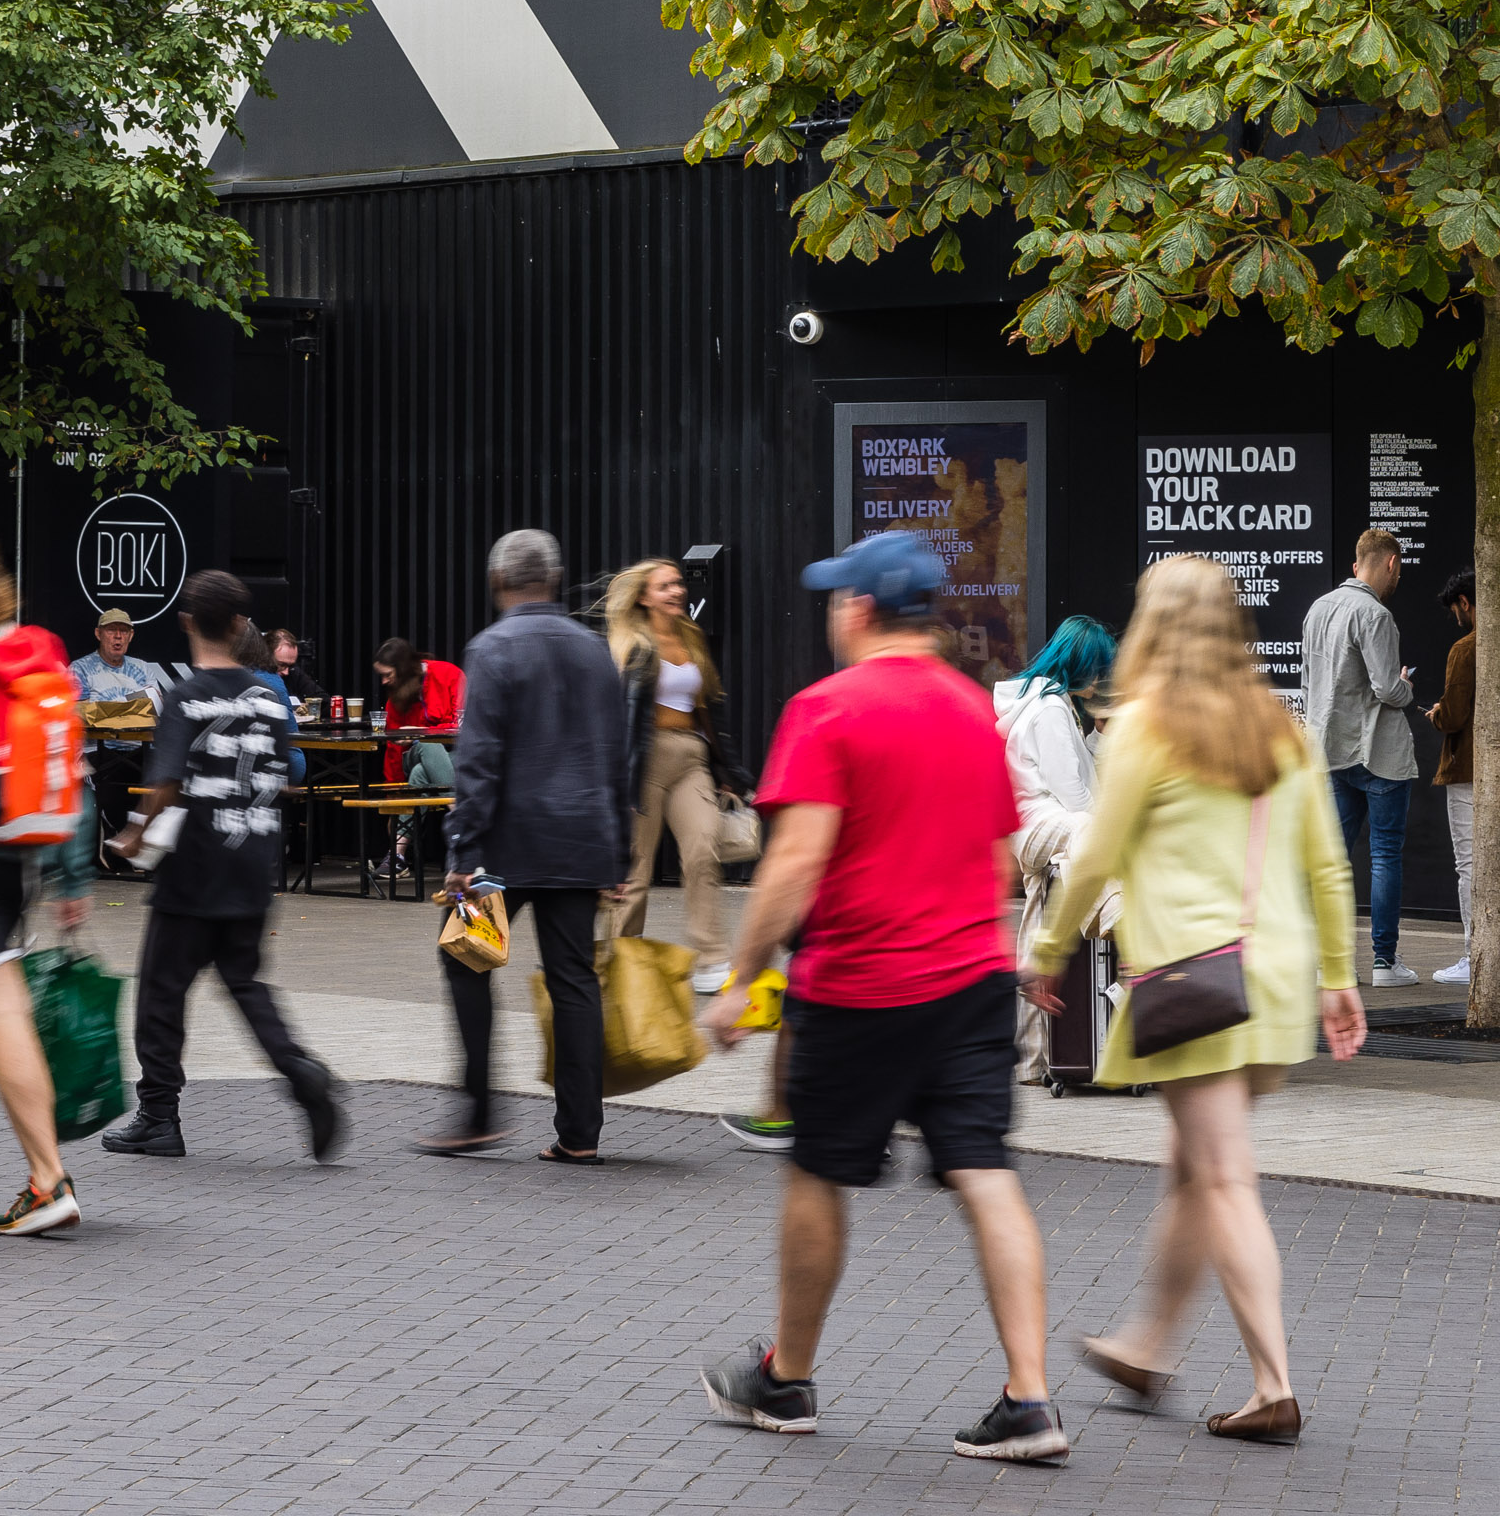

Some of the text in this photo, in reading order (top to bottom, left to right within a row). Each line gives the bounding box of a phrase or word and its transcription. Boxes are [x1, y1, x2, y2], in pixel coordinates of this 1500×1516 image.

[862, 438, 946, 457] BOXPARK
[862, 457, 952, 477] WEMBLEY
[1146, 446, 1296, 473] DOWNLOAD
[1146, 476, 1219, 503] YOUR
[864, 500, 952, 519] DELIVERY
[1146, 504, 1312, 531] BLACK CARD
[96, 531, 166, 587] BOKI
[1213, 551, 1257, 564] POINTS
[1260, 551, 1271, 564] &
[1273, 550, 1323, 564] OFFERS
[1244, 579, 1279, 592] SITES
[1272, 663, 1288, 674] VIA
